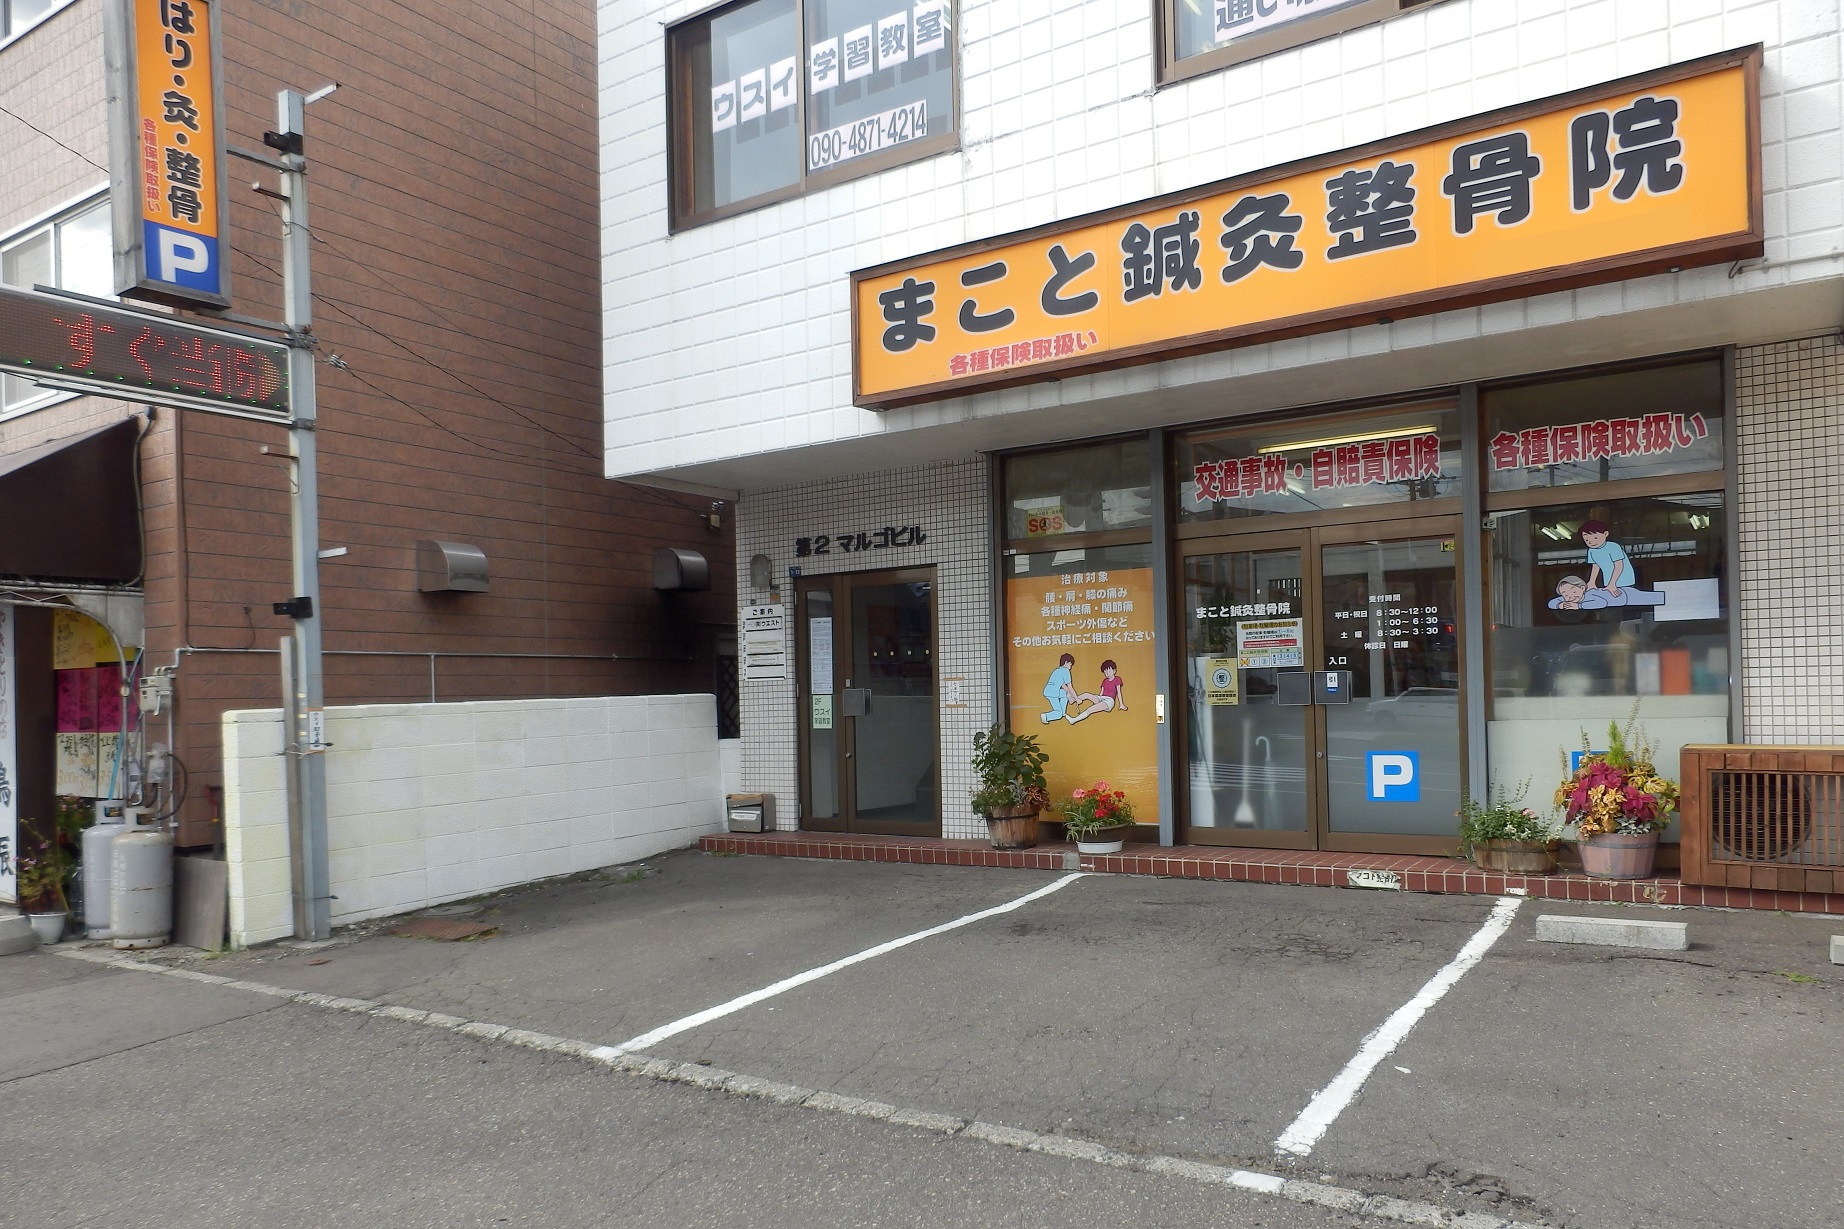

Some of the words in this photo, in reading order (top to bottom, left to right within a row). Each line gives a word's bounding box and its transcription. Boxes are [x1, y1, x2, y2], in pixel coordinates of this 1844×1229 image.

[713, 66, 794, 122] ウスイ
[812, 10, 942, 81] 学習教室
[159, 0, 202, 225] はり・灸・整骨
[811, 102, 926, 168] 090-4871-4214
[143, 118, 162, 213] 各種保険取扱い
[877, 96, 1684, 355] まこと鍼灸整骨院
[159, 228, 209, 284] P
[949, 329, 1099, 378] 各種保険取扱い
[1491, 412, 1709, 471] 各種保険取扱い
[1194, 433, 1442, 503] 交通事故・自賠責保険
[1028, 515, 1063, 533] SOS
[1061, 571, 1109, 585] 治療対象
[1041, 601, 1134, 617] 各種神経痛・関節痛
[1045, 587, 1128, 603] 腰・肩・膝の痛み
[1195, 602, 1291, 619] まこと鍼灸整骨院
[1369, 594, 1401, 603] 受付時間
[1046, 616, 1128, 631] スポーツ外傷など
[1335, 610, 1368, 619] 平日・祝日
[1012, 631, 1156, 648] その他お気軽にご相談ください
[1328, 656, 1347, 665] 入口
[1372, 754, 1414, 798] P
